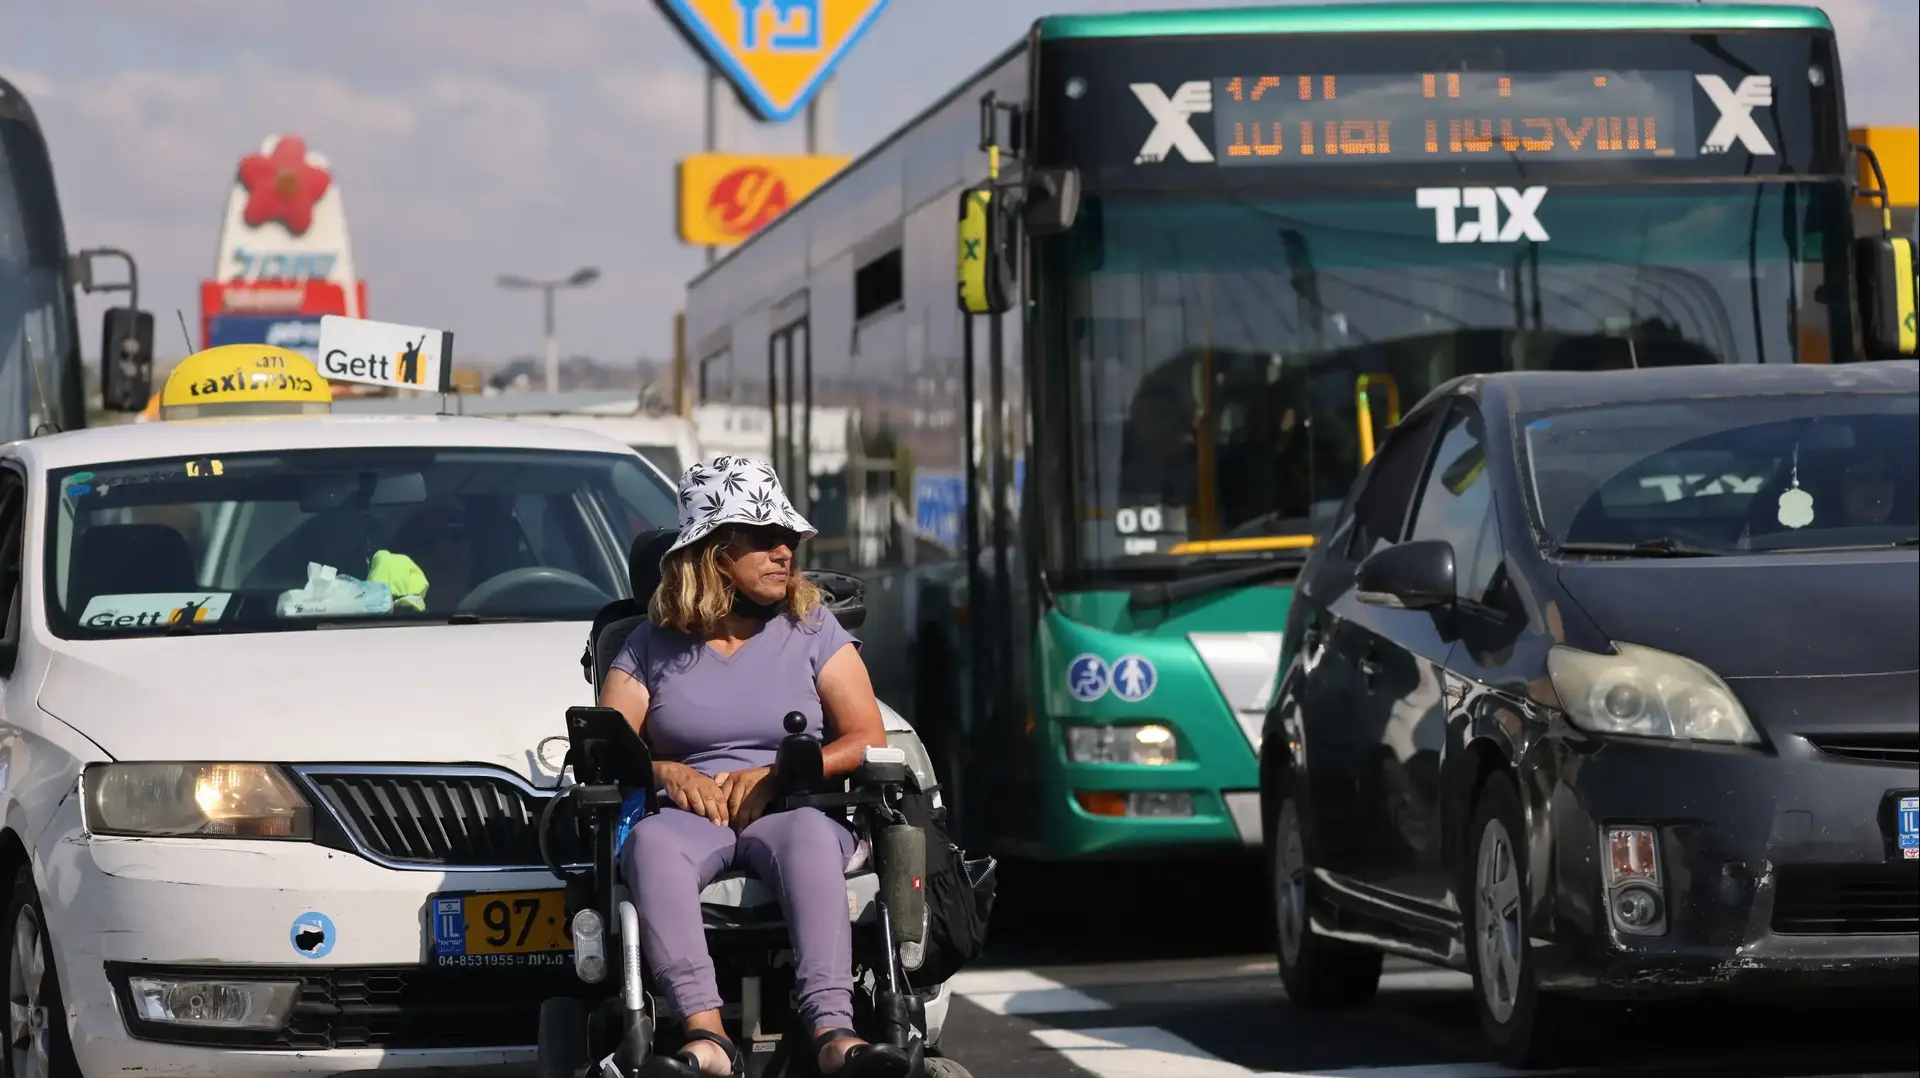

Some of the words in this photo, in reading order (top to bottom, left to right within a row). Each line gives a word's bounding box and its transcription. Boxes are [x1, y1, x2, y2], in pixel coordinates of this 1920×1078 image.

[1416, 186, 1550, 243] אגד
[325, 349, 389, 380] Gett
[86, 611, 162, 629] Gett
[442, 915, 459, 938] IL
[438, 955, 514, 966] 04-8531955
